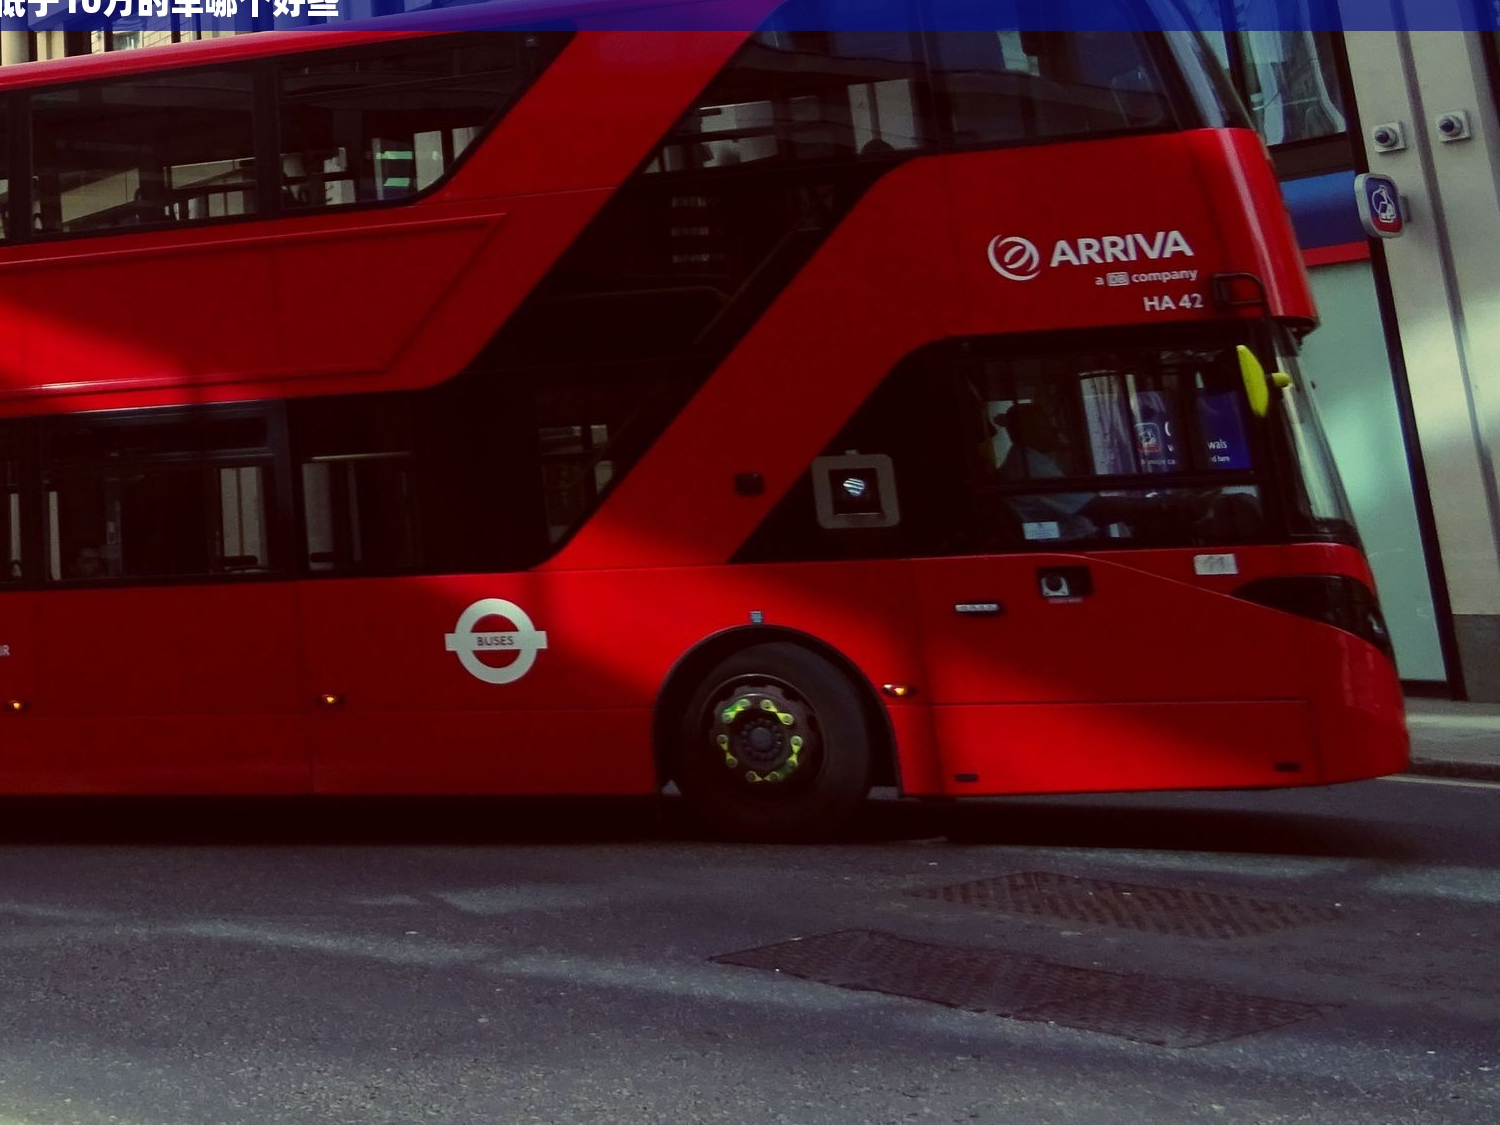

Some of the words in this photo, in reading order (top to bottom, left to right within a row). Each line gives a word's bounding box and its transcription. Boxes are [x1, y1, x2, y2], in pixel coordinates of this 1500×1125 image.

[1050, 230, 1194, 267] ARRIVA
[1095, 277, 1105, 286] a
[1131, 270, 1198, 283] company
[1143, 295, 1177, 312] HA
[1179, 293, 1204, 309] 42
[476, 635, 515, 647] BUSES
